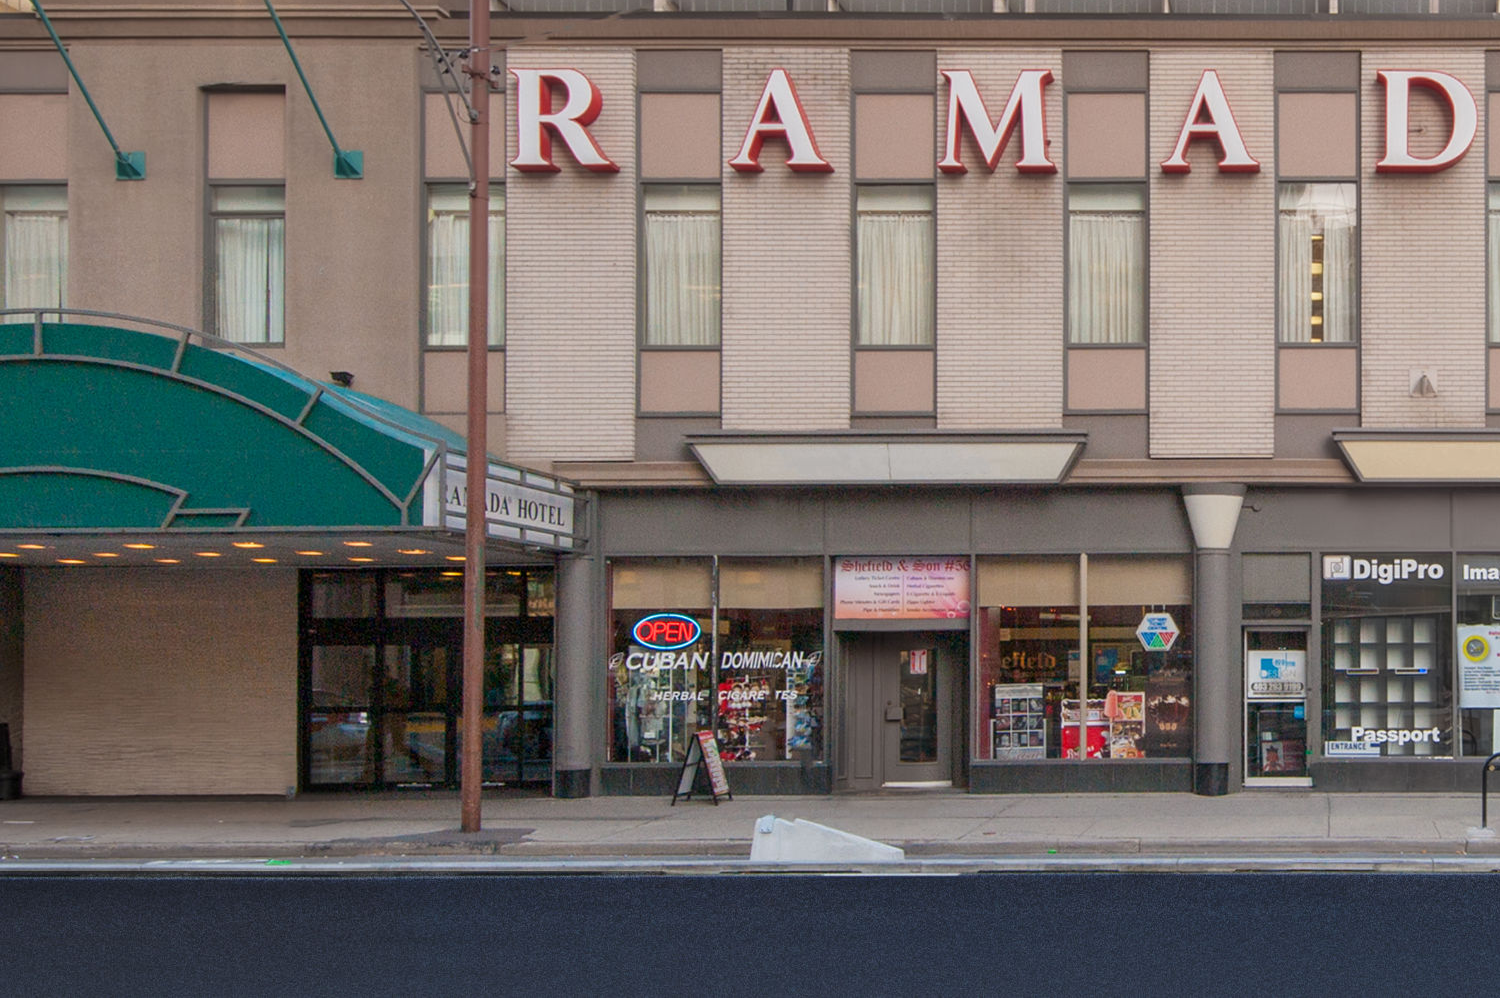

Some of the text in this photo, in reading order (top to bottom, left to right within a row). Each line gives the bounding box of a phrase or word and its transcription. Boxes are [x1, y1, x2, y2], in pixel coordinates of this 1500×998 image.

[444, 484, 565, 527] ADA HOTEL
[898, 559, 909, 572] &
[912, 560, 940, 572] Son
[1353, 558, 1444, 585] DigiPro
[636, 621, 694, 642] OPEN
[625, 651, 709, 670] CUBAN
[653, 690, 798, 701] HERBAL CIGARETES
[1351, 726, 1441, 746] Passport
[1331, 742, 1366, 751] ENTRANCE
